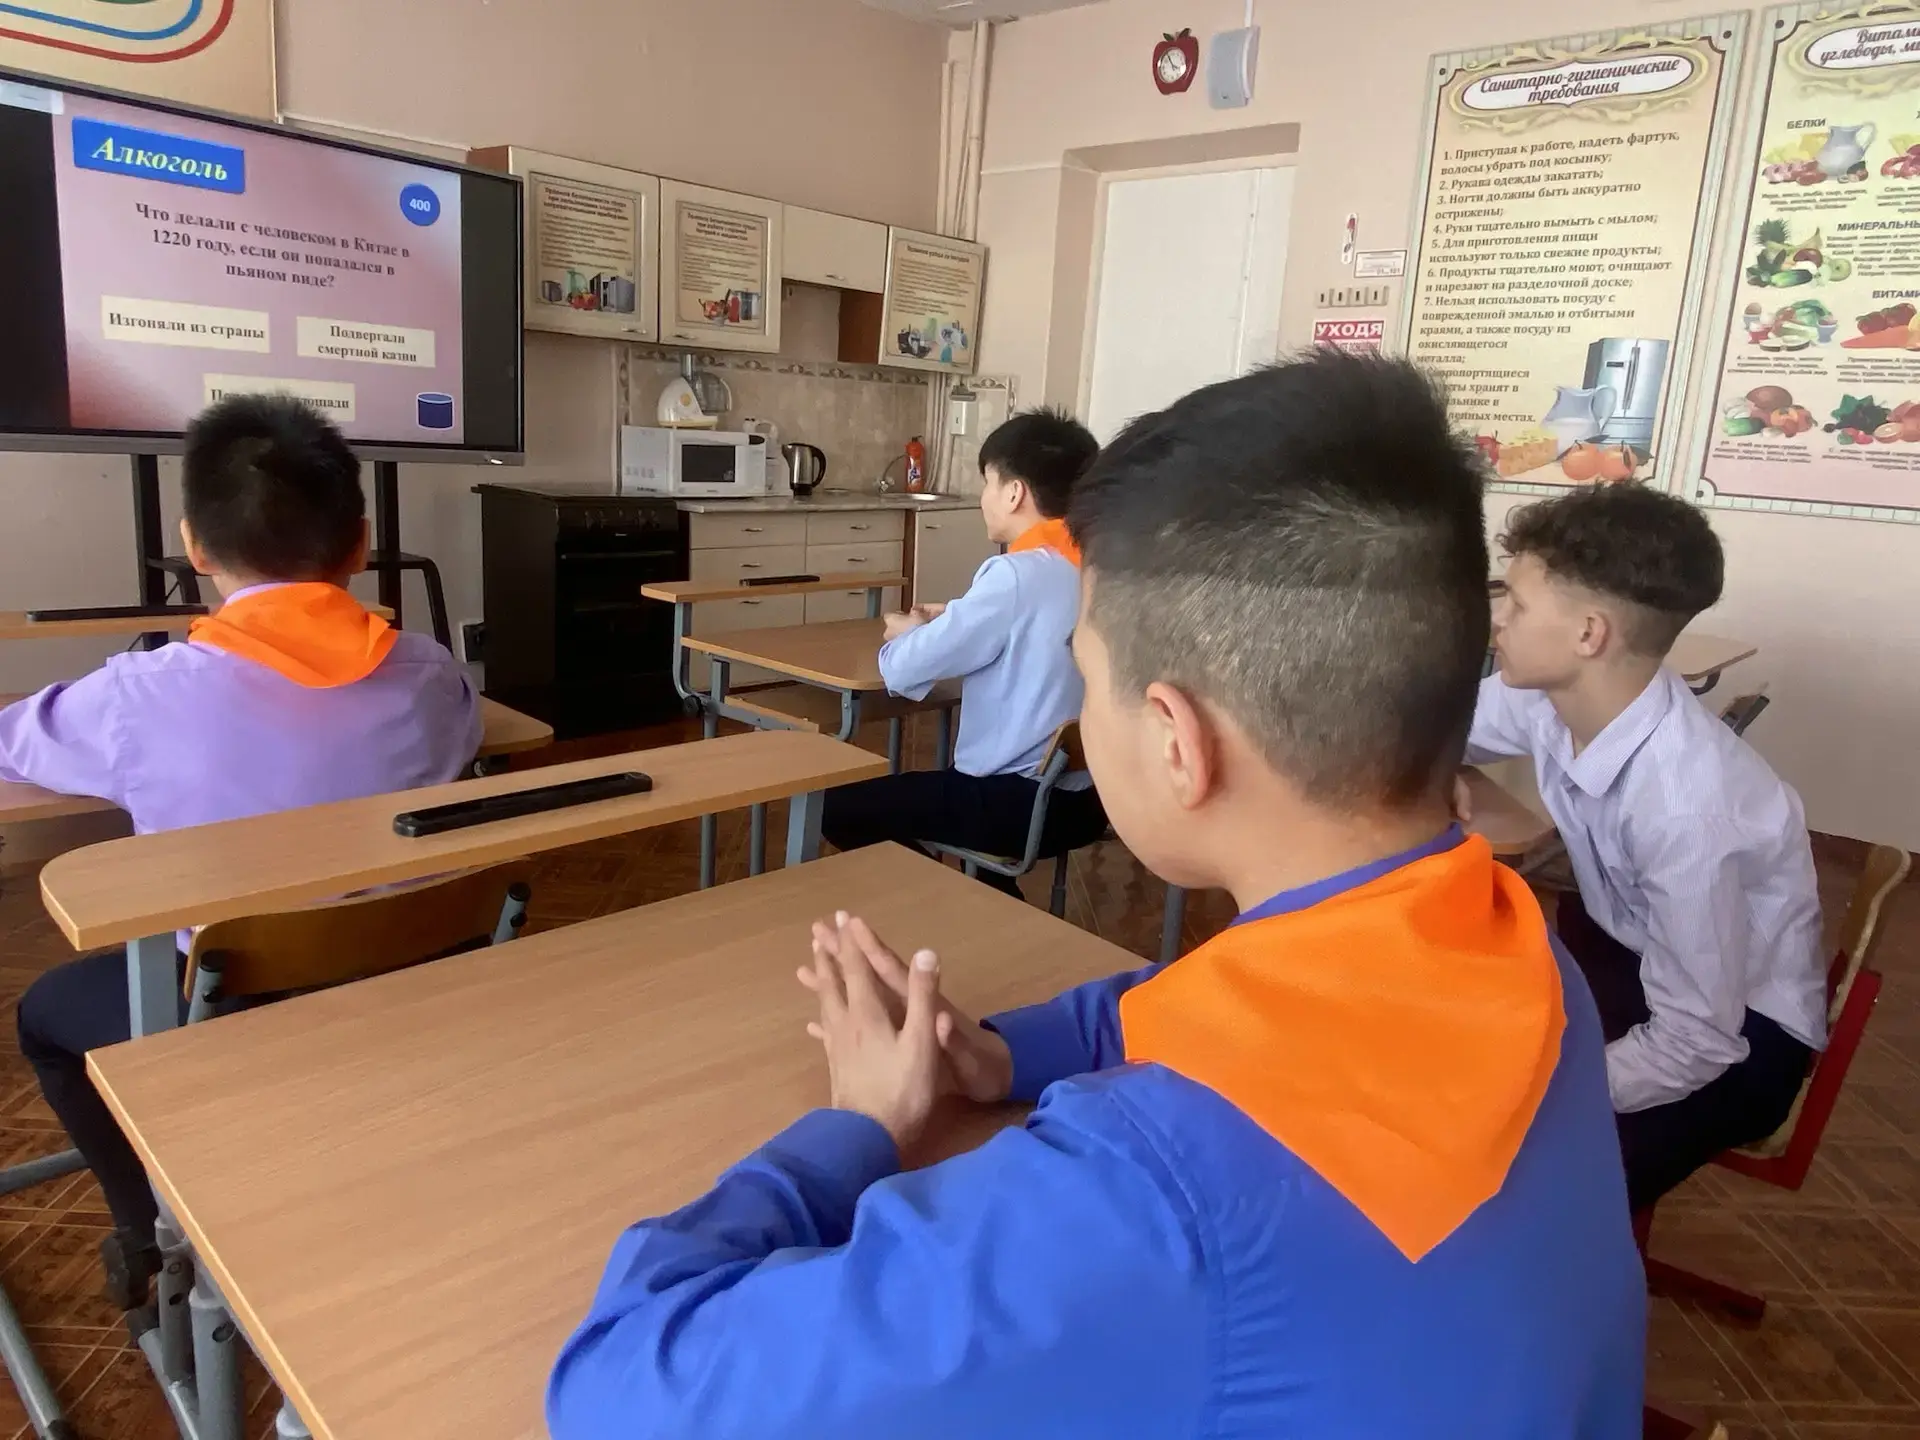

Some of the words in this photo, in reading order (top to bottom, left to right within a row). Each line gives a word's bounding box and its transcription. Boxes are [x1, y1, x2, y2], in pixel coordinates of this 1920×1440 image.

[1820, 42, 1896, 66] углеводы,
[1480, 59, 1680, 93] Санитарно-гигиенические
[1528, 80, 1620, 103] требования
[1787, 117, 1826, 129] БЕЛКИ
[1444, 151, 1453, 160] 1.
[1455, 145, 1517, 161] Приступая
[1520, 145, 1528, 153] к
[1530, 140, 1575, 154] работе,
[1579, 136, 1623, 148] надеть
[1627, 131, 1680, 146] фартук,
[91, 136, 229, 181] Алкоголь
[1441, 164, 1483, 175] волосы
[1486, 159, 1526, 173] убрать
[1529, 158, 1550, 169] под
[1554, 153, 1612, 165] косынку;
[1439, 180, 1448, 190] 2.
[1451, 179, 1491, 191] Рукава
[1494, 174, 1541, 186] одежды
[1544, 169, 1604, 182] закатать;
[1437, 195, 1446, 205] 3.
[1450, 193, 1484, 204] Ногти
[1486, 190, 1535, 202] должны
[1538, 187, 1569, 197] быть
[1572, 183, 1642, 196] аккуратно
[410, 198, 431, 212] 400
[1435, 208, 1504, 220] острижены;
[136, 202, 170, 221] Что
[174, 212, 236, 232] делали
[240, 223, 249, 233] с
[254, 225, 336, 247] человеком
[341, 238, 350, 249] в
[354, 237, 398, 257] Китае
[402, 248, 410, 258] в
[1433, 225, 1442, 234] 4.
[1445, 223, 1472, 235] Руки
[1475, 218, 1541, 232] тщательно
[1543, 217, 1595, 228] вымыть
[1598, 216, 1605, 225] с
[1607, 213, 1659, 224] мылом;
[1431, 239, 1440, 248] 5.
[1442, 238, 1465, 249] Для
[1467, 233, 1560, 249] приготовления
[1562, 232, 1598, 243] пищи
[153, 229, 192, 247] 1220
[196, 238, 235, 256] году,
[240, 244, 277, 259] если
[282, 250, 300, 263] он
[304, 253, 382, 274] попадался
[387, 265, 395, 276] в
[1429, 250, 1496, 263] используют
[1499, 249, 1541, 260] только
[1543, 247, 1589, 258] свежие
[1592, 245, 1662, 259] продукты;
[226, 265, 286, 282] пьяном
[291, 274, 335, 288] виде?
[1427, 268, 1436, 277] 6.
[1439, 266, 1496, 279] Продукты
[1499, 263, 1566, 276] тщательно
[1568, 262, 1604, 273] моют,
[1607, 260, 1672, 272] очищают
[1425, 284, 1433, 292] и
[1435, 282, 1489, 294] нарезают
[1492, 281, 1505, 290] на
[1508, 277, 1589, 292] разделочной
[1591, 277, 1633, 288] доске;
[1424, 296, 1432, 306] 7.
[1435, 296, 1475, 306] Нельзя
[1478, 294, 1560, 305] использовать
[1562, 293, 1606, 305] посуду
[1608, 294, 1616, 302] с
[1422, 309, 1505, 322] поврежденной
[1508, 309, 1554, 319] эмалью
[1557, 309, 1565, 319] и
[1568, 307, 1635, 318] отбитыми
[108, 312, 185, 332] Изгоняли
[191, 323, 206, 334] из
[210, 325, 265, 339] страны
[1316, 323, 1382, 338] УХОДЯ
[1420, 325, 1464, 337] краями,
[1466, 326, 1473, 334] а
[1475, 324, 1511, 334] также
[1513, 324, 1554, 336] посуду
[1557, 325, 1571, 333] из
[330, 325, 405, 345] Подвергали
[317, 344, 378, 359] смертной
[382, 351, 417, 362] казни
[1418, 340, 1508, 351] окисляющегося
[1416, 355, 1466, 364] металла;
[1469, 383, 1510, 394] хранят
[1512, 385, 1519, 393] в
[1493, 398, 1500, 407] в
[1493, 412, 1536, 422] местах.
